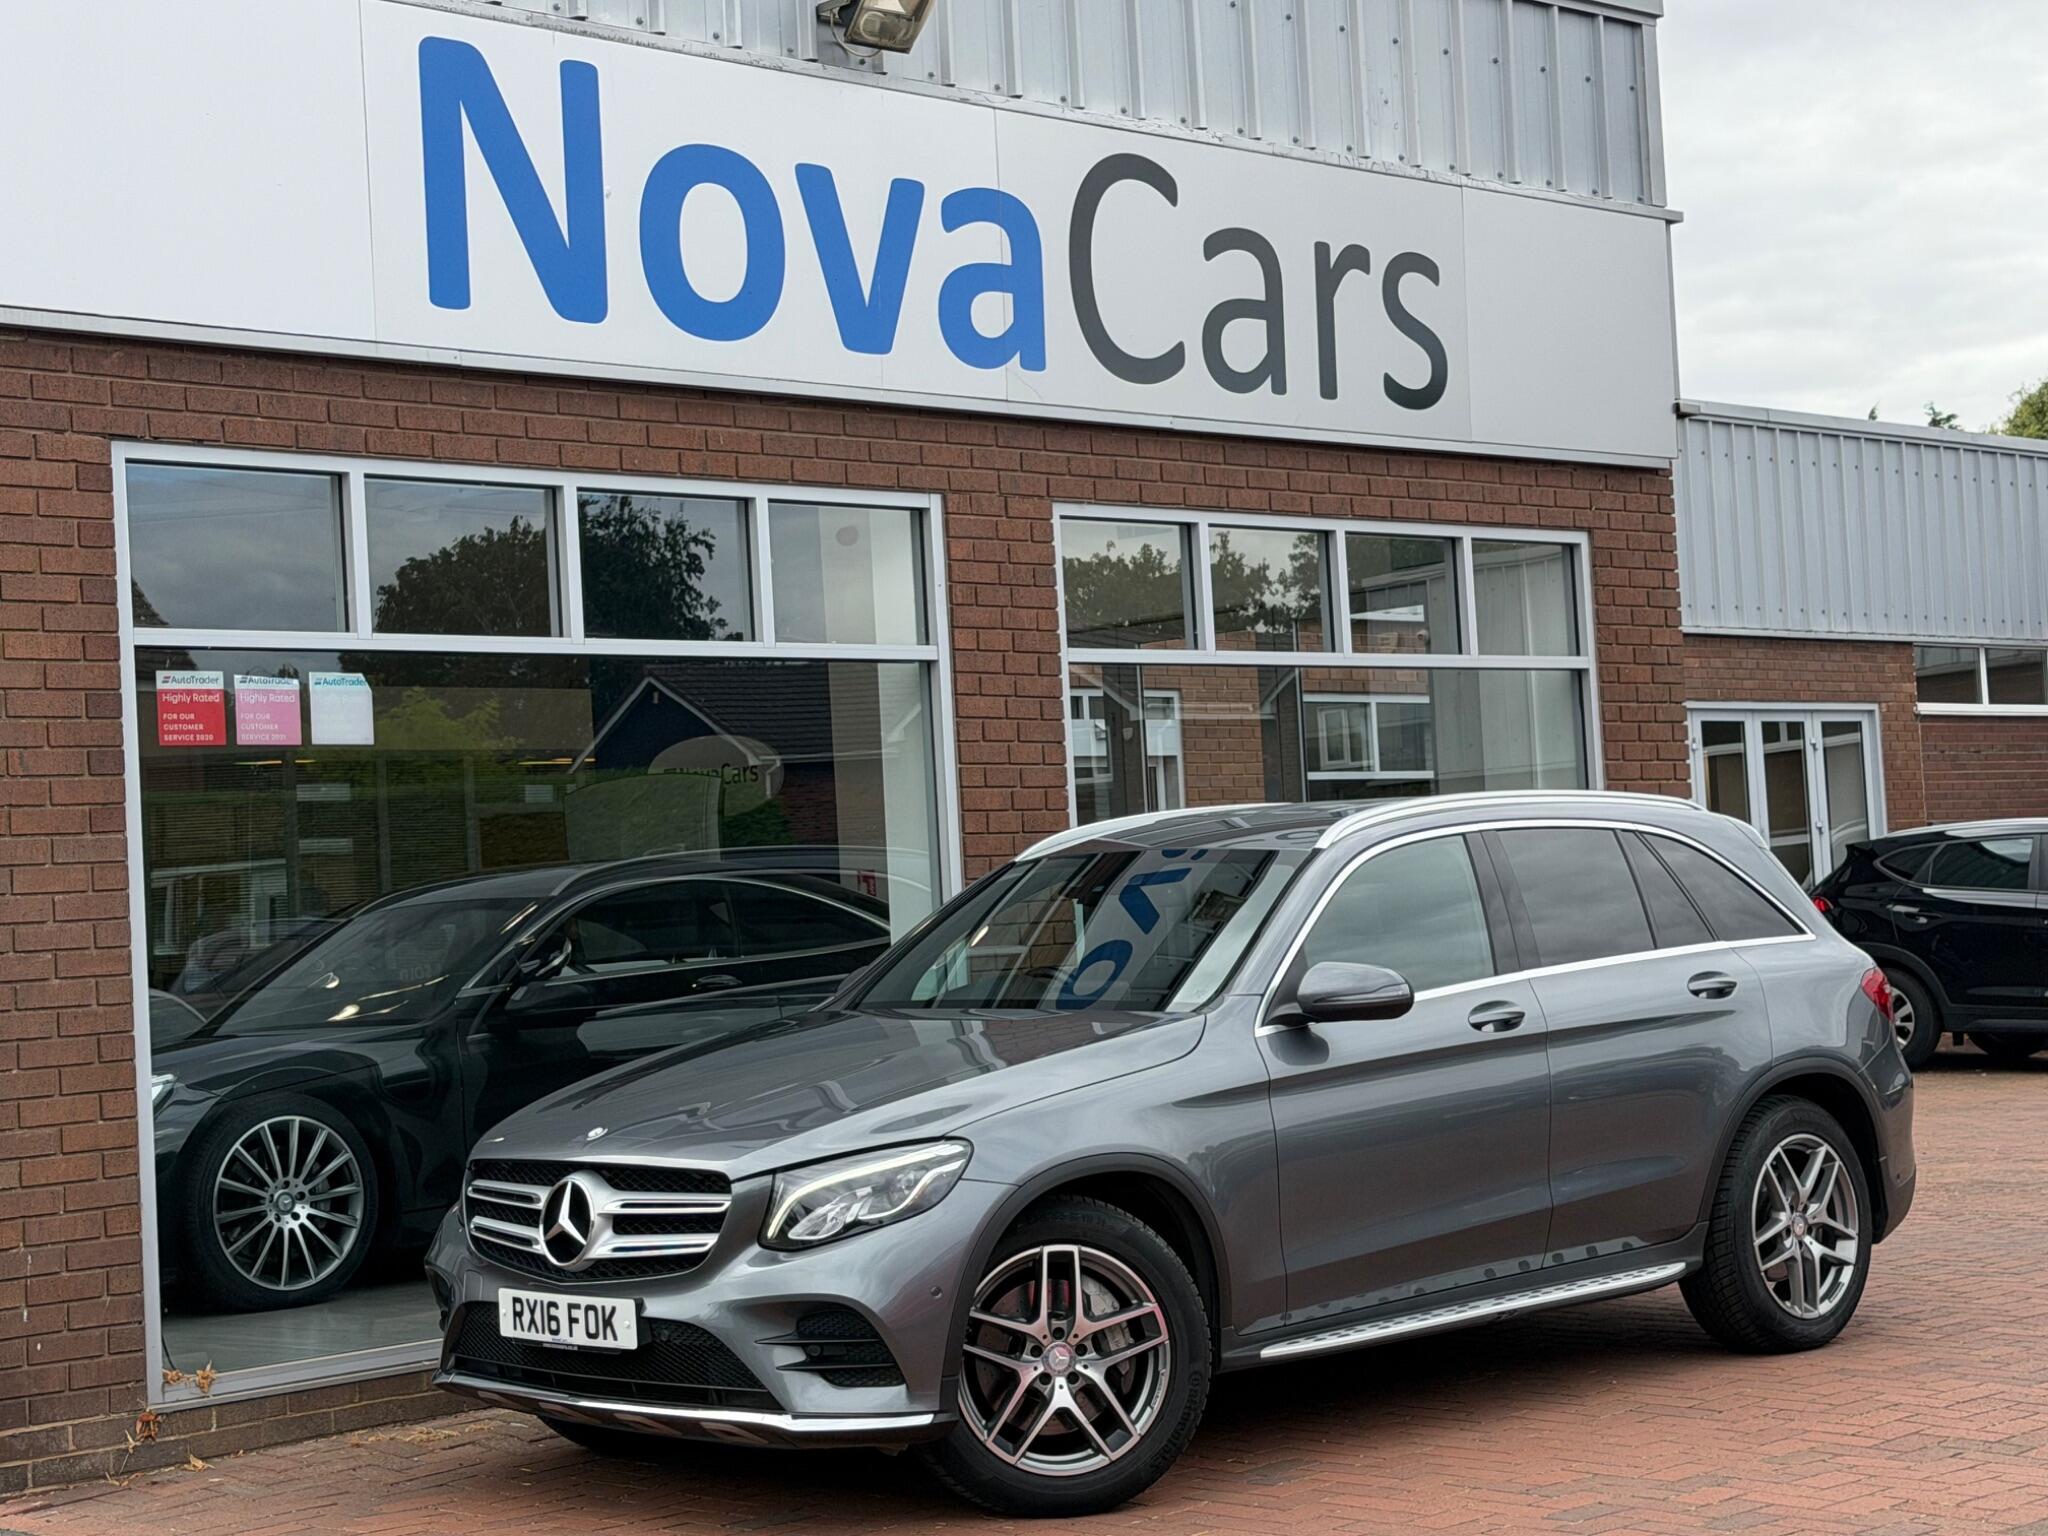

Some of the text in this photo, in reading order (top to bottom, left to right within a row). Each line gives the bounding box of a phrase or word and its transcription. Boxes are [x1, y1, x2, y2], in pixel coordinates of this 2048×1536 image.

[418, 36, 1449, 411] NovaCars
[171, 675, 219, 685] AutoTrader
[162, 692, 220, 704] Highly Rated
[240, 692, 295, 704] Highly Rated
[163, 723, 204, 731] CUSTOMER
[512, 1296, 618, 1342] RX16 FOK
